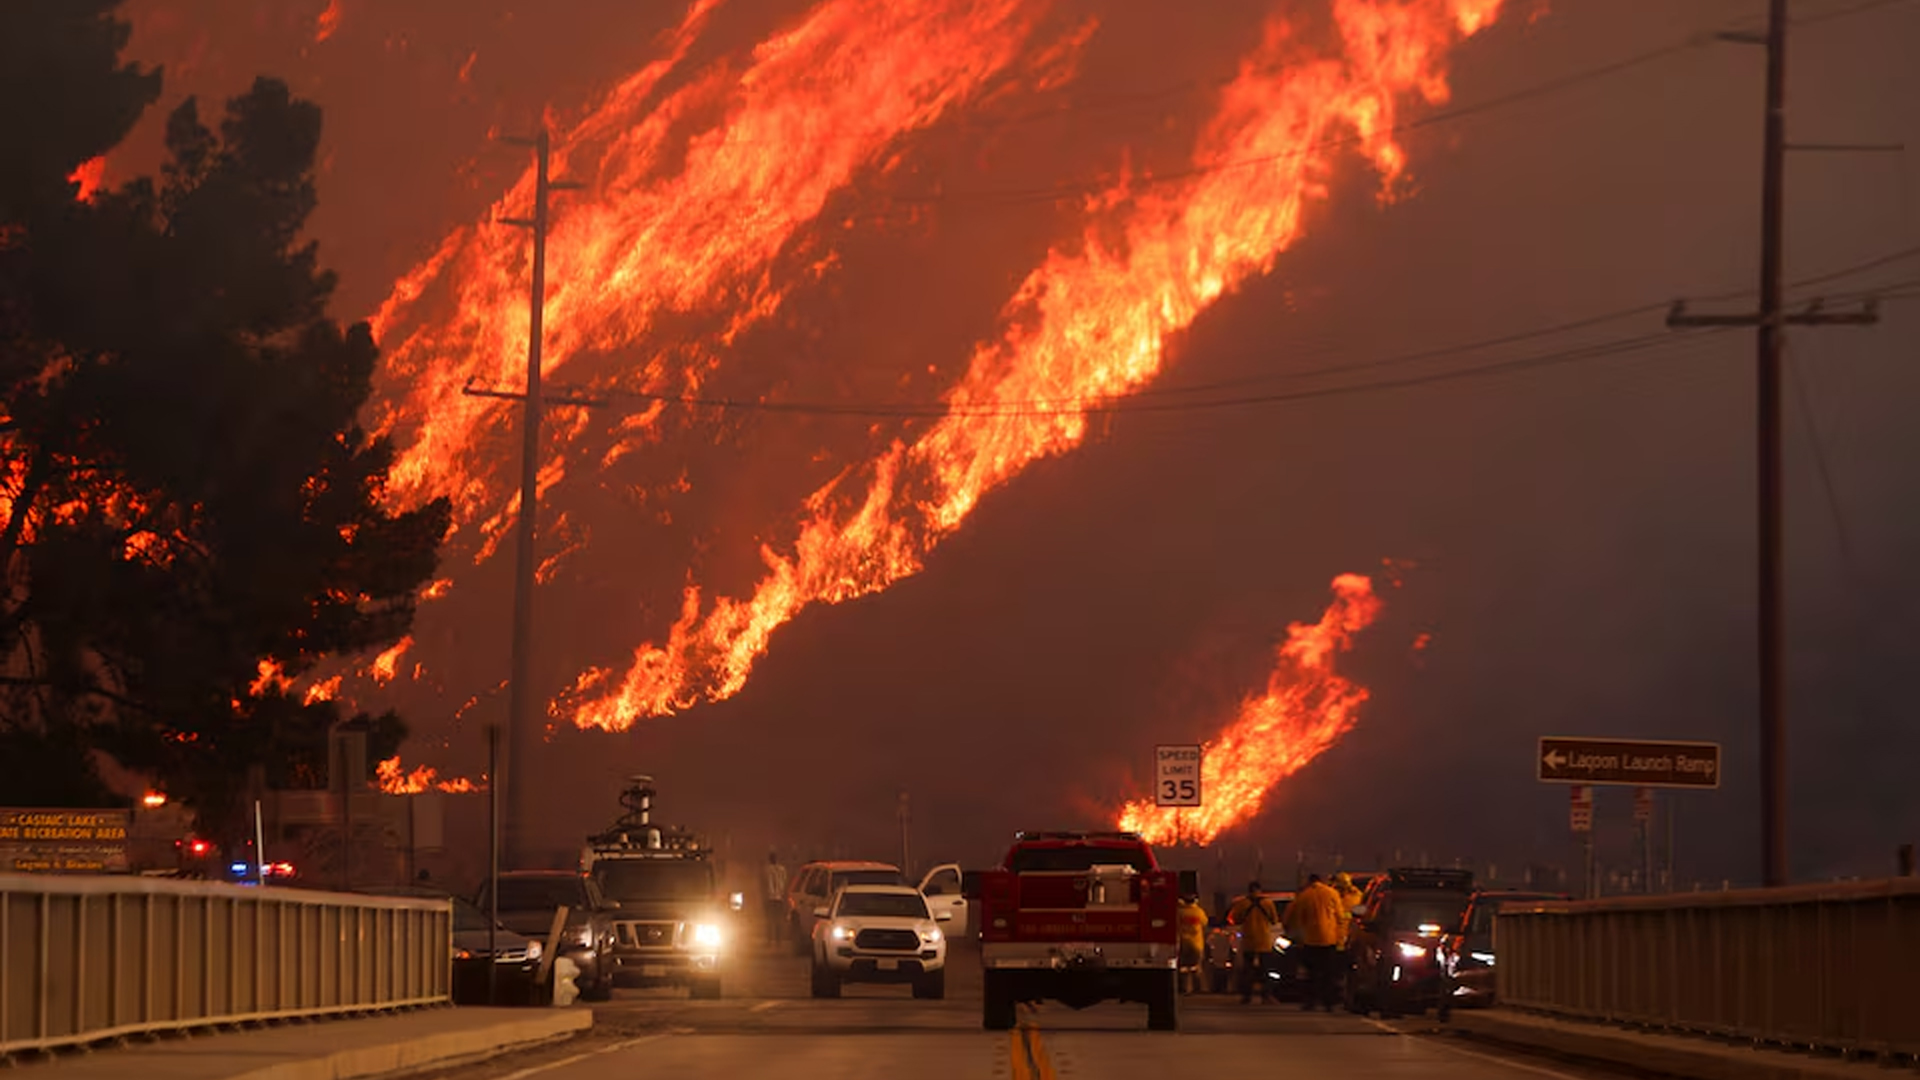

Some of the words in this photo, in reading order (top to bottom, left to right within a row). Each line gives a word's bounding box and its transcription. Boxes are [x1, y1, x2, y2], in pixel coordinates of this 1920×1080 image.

[1159, 751, 1198, 760] SPEED
[1163, 765, 1193, 775] LIMIT
[1568, 750, 1619, 773] Lagoon
[1622, 754, 1672, 771] Launch
[1675, 755, 1715, 778] Ramp
[1162, 780, 1196, 800] 35
[19, 814, 64, 826] CASTAIC
[67, 815, 97, 827] LAKE
[23, 827, 93, 838] RECREATION
[96, 827, 126, 838] AREA
